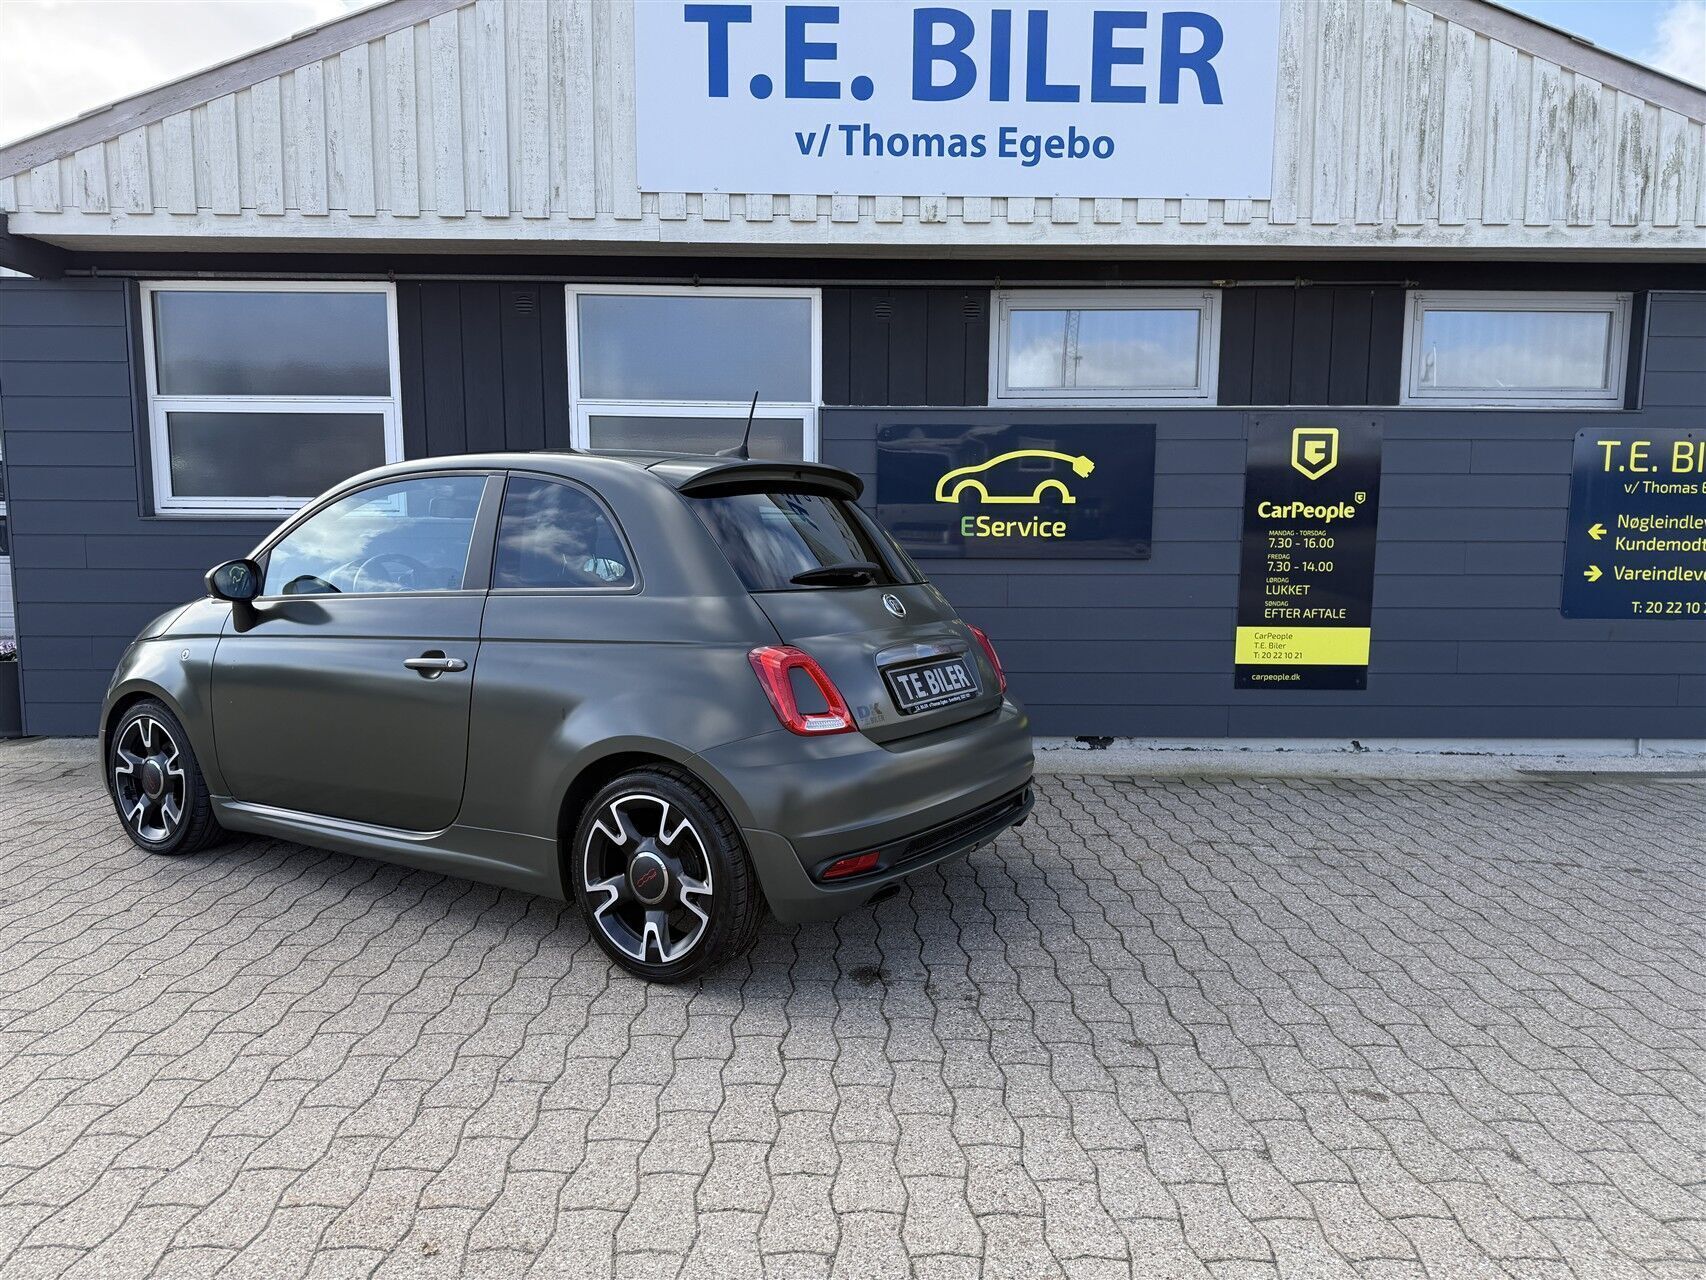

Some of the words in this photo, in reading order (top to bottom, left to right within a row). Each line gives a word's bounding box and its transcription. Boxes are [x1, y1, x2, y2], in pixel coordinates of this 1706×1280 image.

[684, 4, 874, 100] T.E.
[911, 7, 1224, 105] BILER
[795, 123, 832, 158] v/
[839, 124, 987, 159] Thomas
[998, 126, 1116, 167] Egebo
[1597, 440, 1658, 473] T.E.
[1624, 481, 1641, 495] v/
[1643, 481, 1698, 494] Thomas
[1257, 501, 1355, 523] CarPeople
[960, 515, 1067, 538] EService
[1617, 514, 1706, 532] Nøgleindle
[1268, 537, 1293, 549] 7.30
[1303, 537, 1335, 549] 16.00
[1267, 561, 1291, 572] 7.30
[1302, 561, 1334, 572] 14.00
[1614, 566, 1706, 581] Vareindlev
[1265, 584, 1311, 596] LUKKET
[1264, 608, 1301, 619] EFTER
[1302, 608, 1347, 619] AFTALE
[1632, 601, 1643, 614] T:
[1645, 601, 1662, 614] 20
[1665, 601, 1682, 614] 22
[1686, 601, 1700, 614] 10
[1254, 632, 1294, 641] CarPeople
[1254, 642, 1267, 650] T.E.
[1268, 642, 1287, 650] Biler
[1254, 652, 1261, 660] T:
[1261, 652, 1272, 660] 20
[1273, 652, 1283, 660] 22
[1284, 652, 1293, 660] 10
[1294, 652, 1303, 660] 21
[923, 664, 971, 695] BILER
[1251, 673, 1301, 683] carpeople.dk
